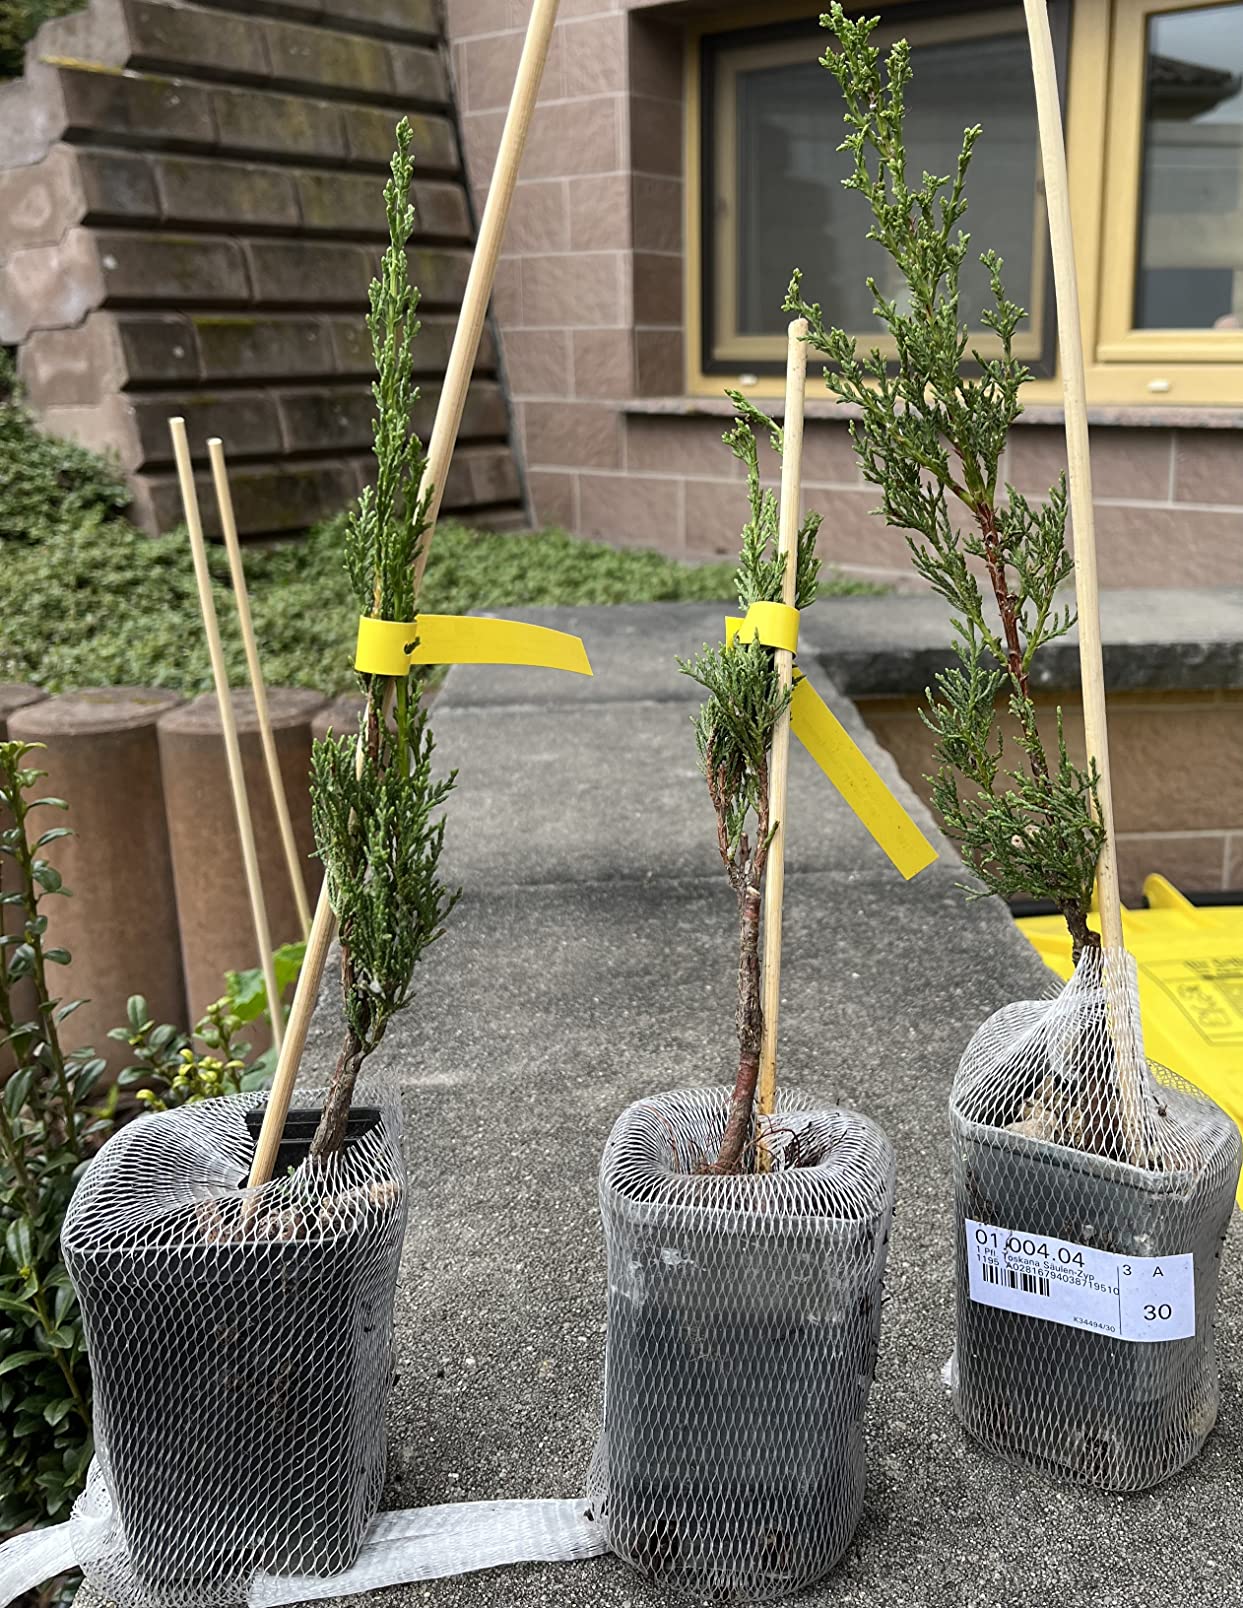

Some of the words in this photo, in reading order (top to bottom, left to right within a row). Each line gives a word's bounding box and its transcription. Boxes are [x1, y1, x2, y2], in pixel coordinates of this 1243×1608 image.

[976, 1229, 1085, 1268] 01.004.04
[976, 1245, 981, 1253] 1
[1043, 1260, 1095, 1281] Säulen-Zyp
[977, 1254, 999, 1266] 1195
[1122, 1264, 1132, 1276] 3
[1152, 1266, 1164, 1278] A
[1143, 1303, 1172, 1321] 30
